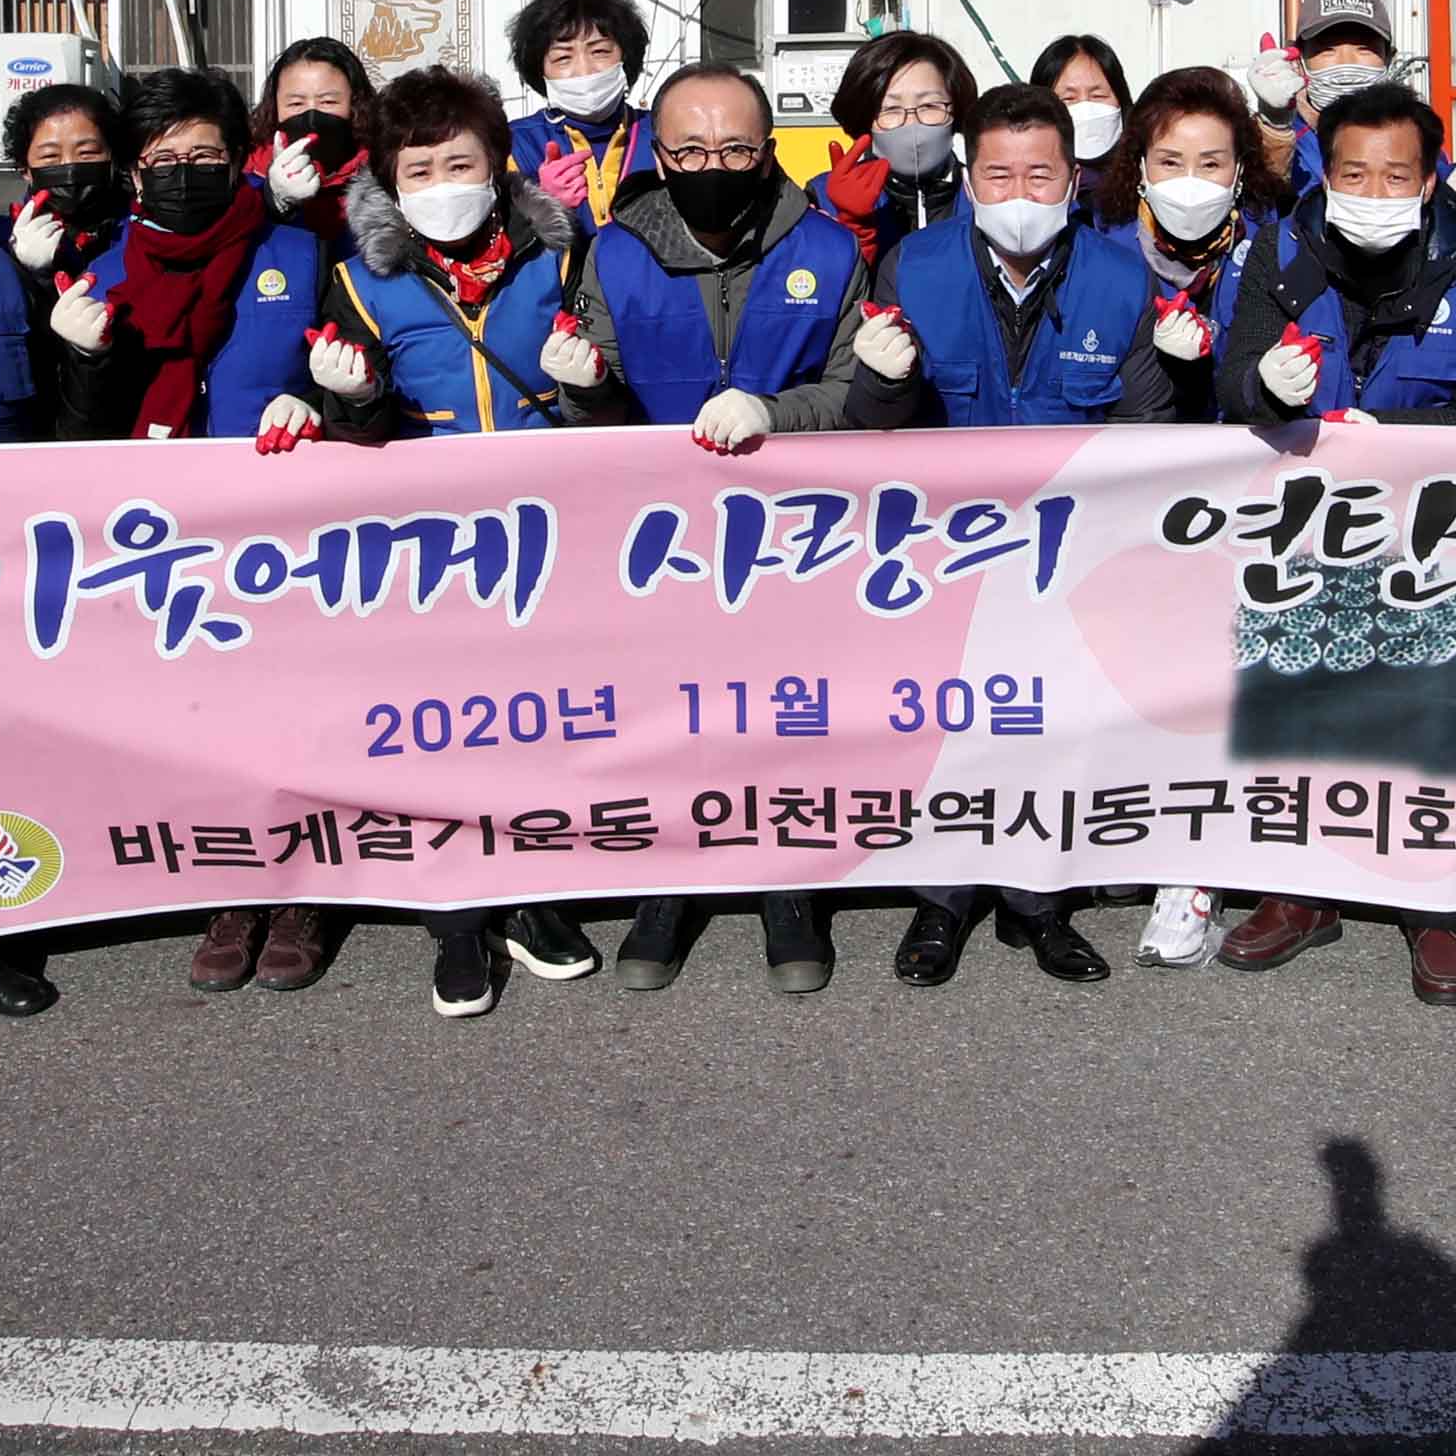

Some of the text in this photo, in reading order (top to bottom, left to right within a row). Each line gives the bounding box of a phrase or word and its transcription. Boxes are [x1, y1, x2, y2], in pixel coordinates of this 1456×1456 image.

[13, 62, 48, 73] Carrier
[628, 488, 1074, 610] 사랑의
[367, 674, 1045, 756] 2020년 11월 30일
[108, 797, 659, 873] 바르게살기운동
